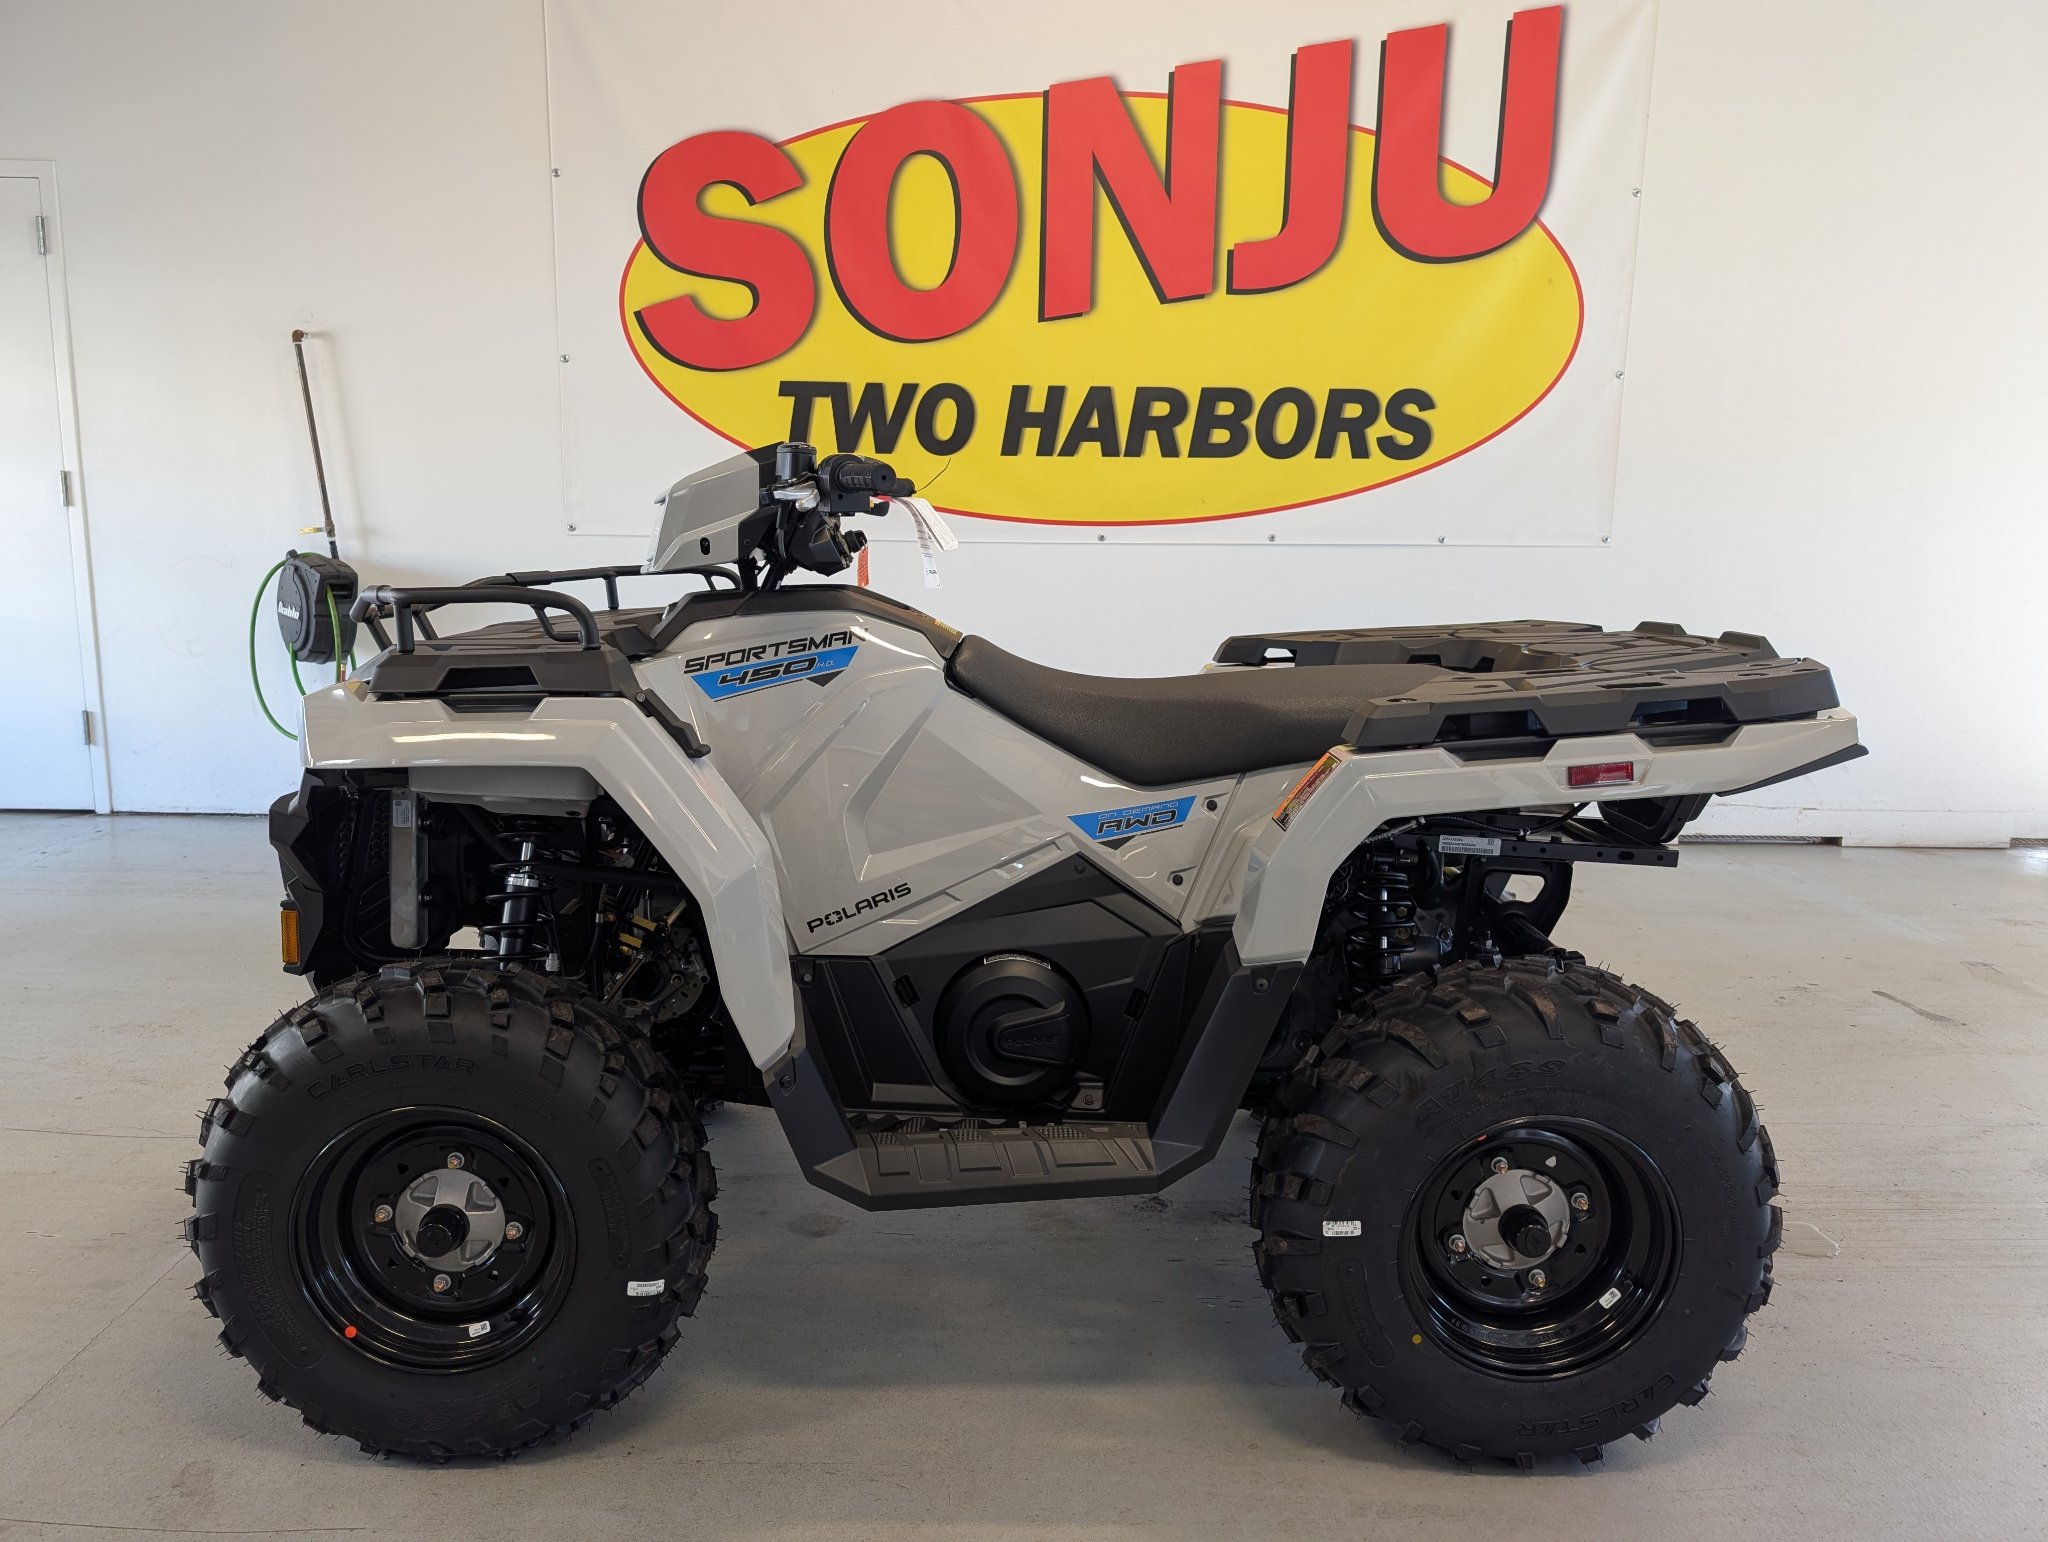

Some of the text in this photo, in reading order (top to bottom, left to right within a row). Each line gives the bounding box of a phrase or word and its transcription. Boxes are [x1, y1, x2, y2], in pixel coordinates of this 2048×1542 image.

[635, 5, 1565, 372] SONJU
[777, 381, 1437, 461] TWO HARBORS
[717, 655, 818, 687] 450
[1096, 809, 1178, 835] AWD
[806, 882, 912, 933] POLARIS
[306, 1052, 480, 1100] CARLSTAR
[1517, 1373, 1677, 1438] CARLSTAR
